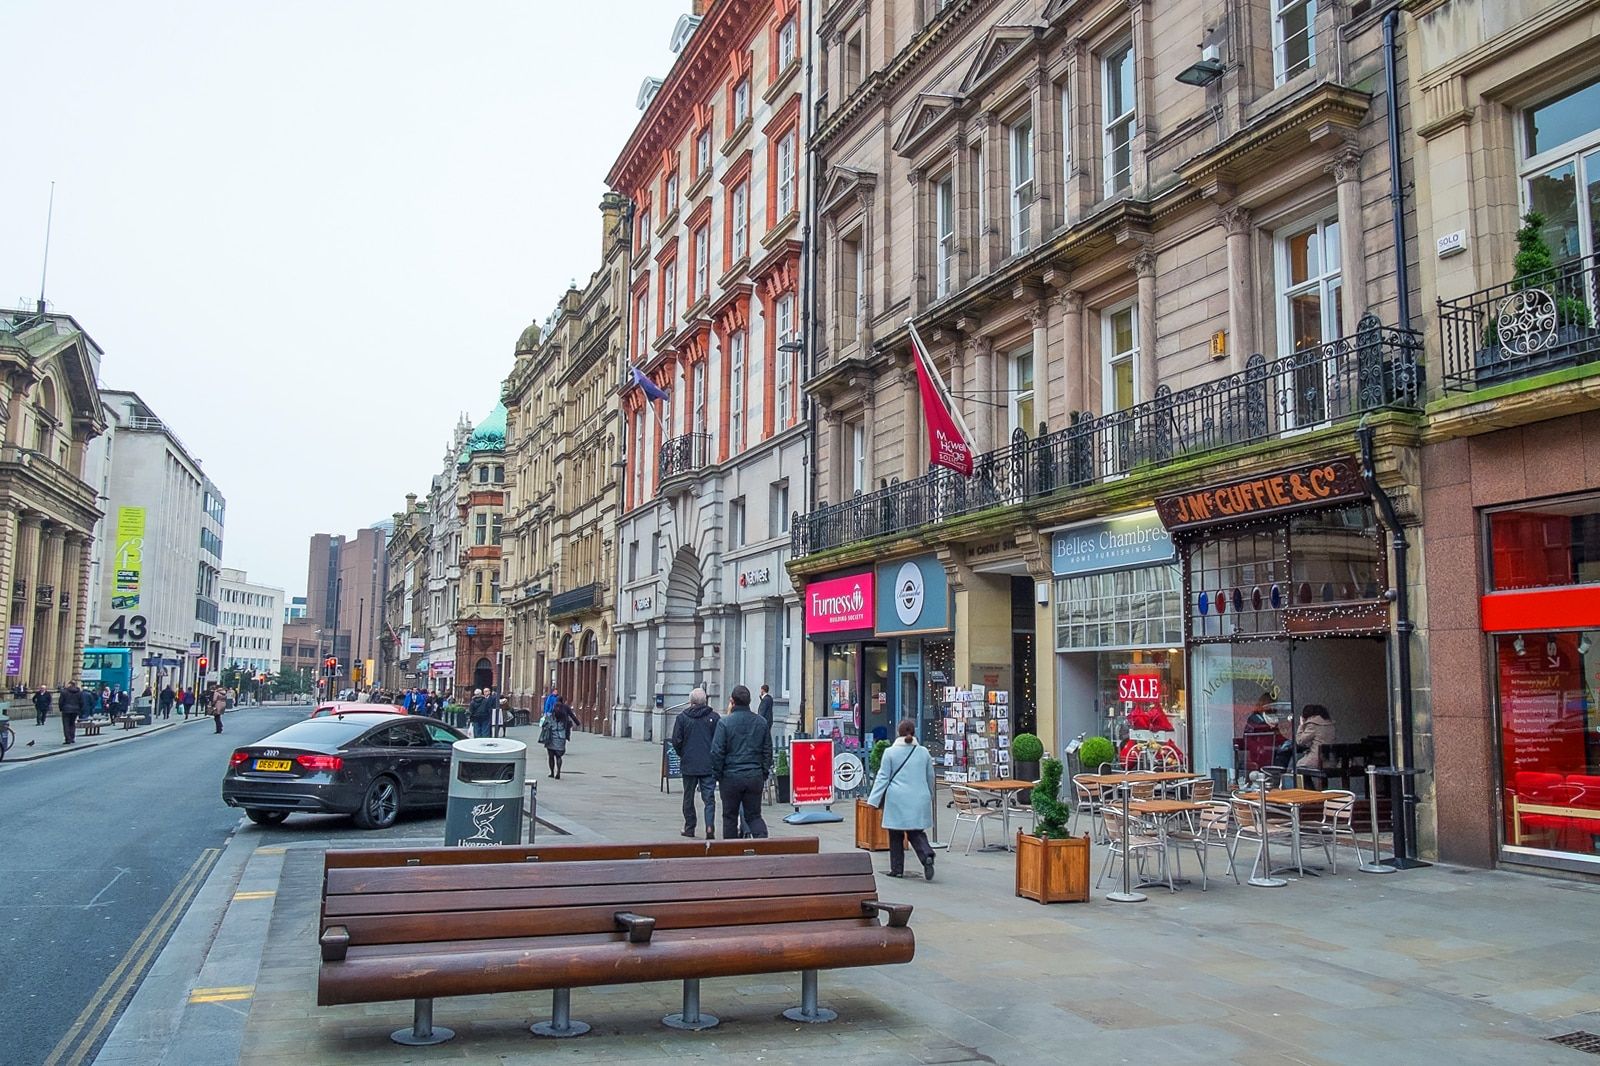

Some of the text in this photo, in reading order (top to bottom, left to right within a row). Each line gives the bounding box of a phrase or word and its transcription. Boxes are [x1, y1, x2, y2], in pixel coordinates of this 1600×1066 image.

[1439, 234, 1459, 247] SOLO
[1290, 474, 1316, 500] &
[1057, 525, 1169, 557] Belles Chambres
[1071, 545, 1152, 563] HOME FURNISHINGS
[812, 593, 851, 616] Furness
[109, 615, 147, 640] 43
[829, 613, 864, 623] BUILDING SOCIETY
[1120, 679, 1159, 699] SALE
[458, 839, 503, 848] Liverpool
